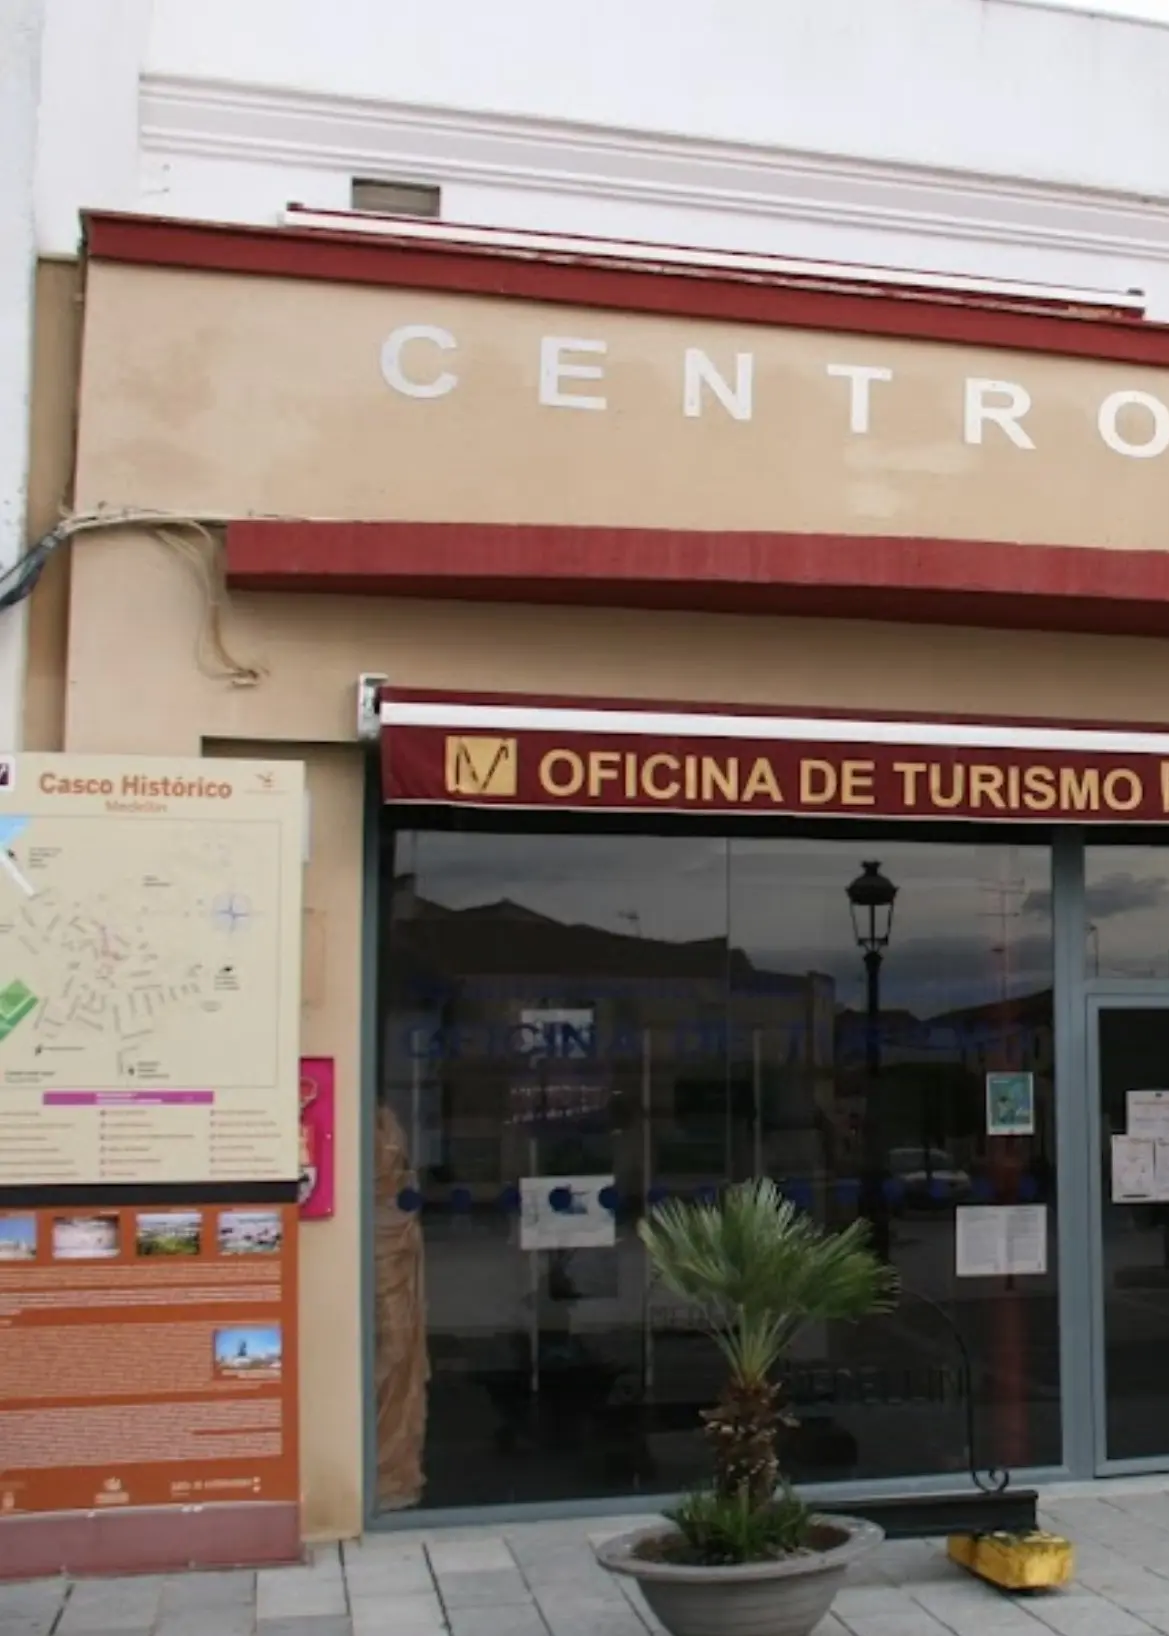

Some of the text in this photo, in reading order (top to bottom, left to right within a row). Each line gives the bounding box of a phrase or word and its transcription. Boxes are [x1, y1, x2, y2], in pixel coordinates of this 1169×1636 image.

[39, 772, 233, 799] Casco Histórico
[538, 749, 1145, 813] OFICINA DE TURISMO
